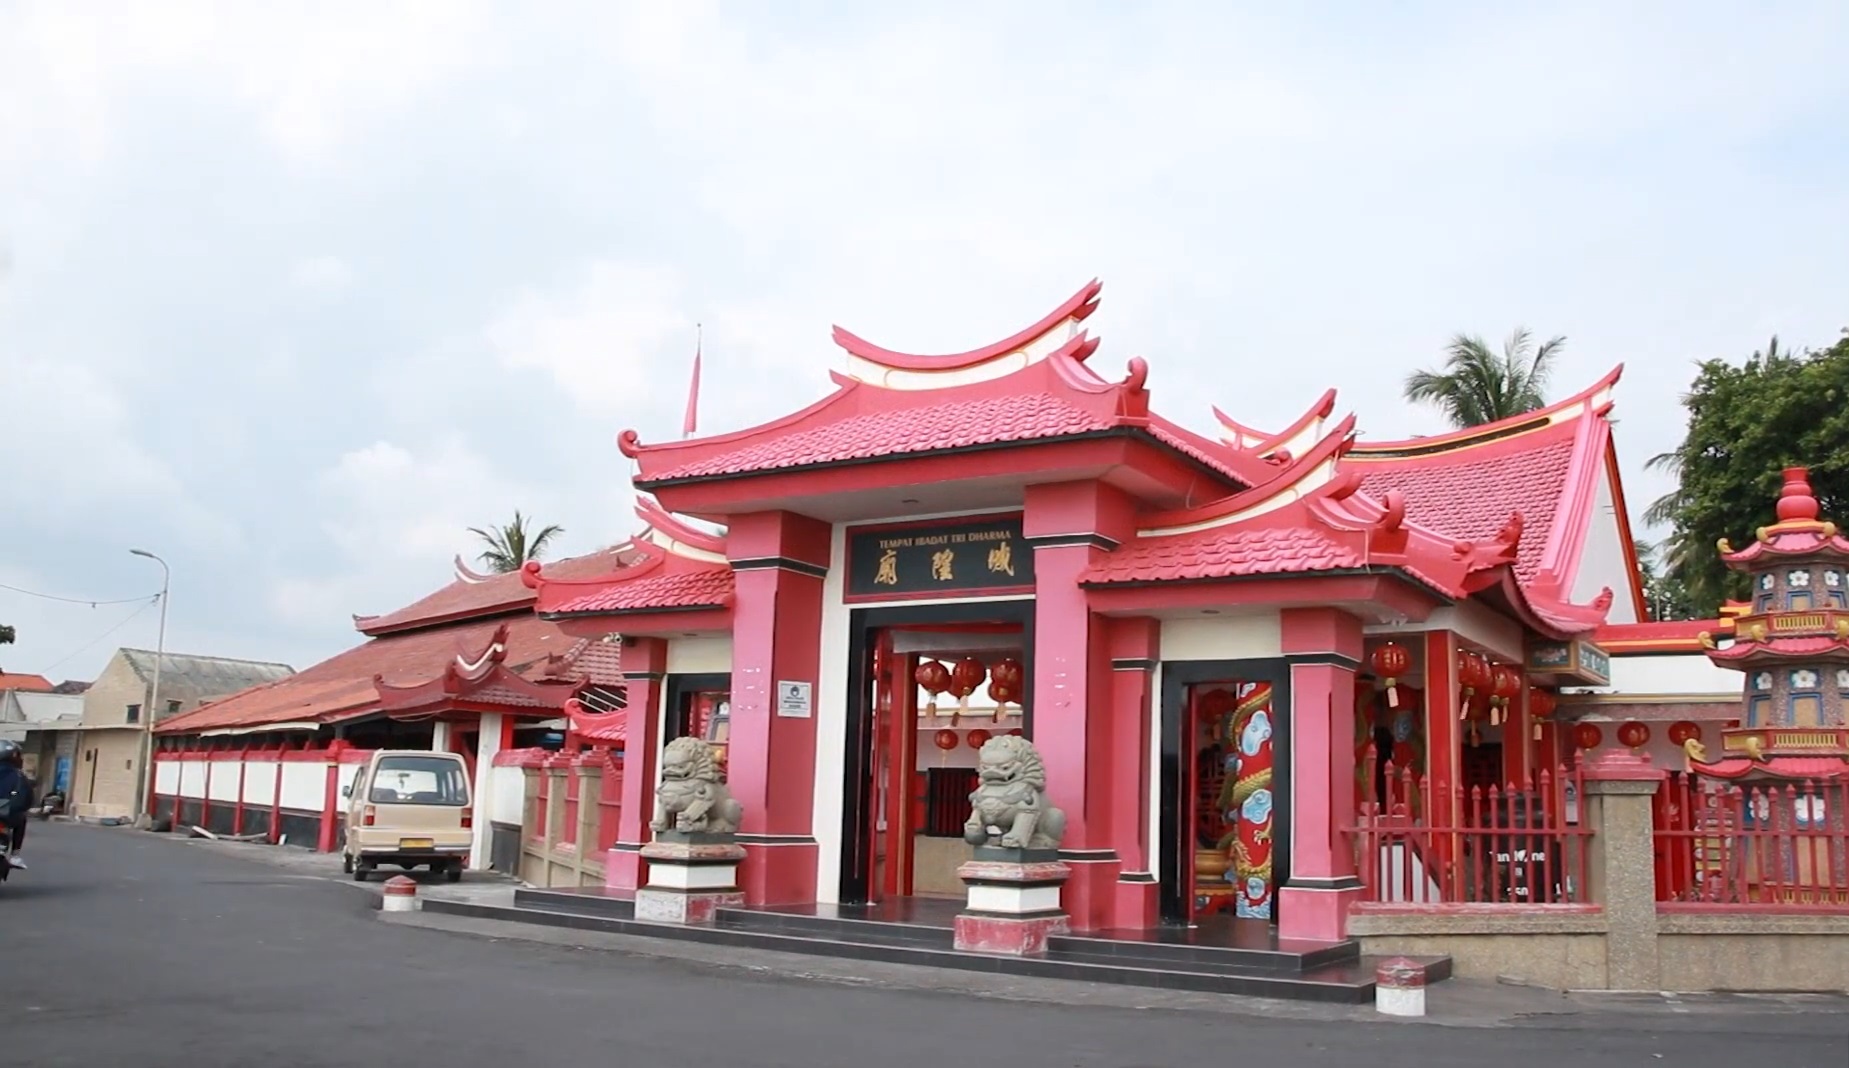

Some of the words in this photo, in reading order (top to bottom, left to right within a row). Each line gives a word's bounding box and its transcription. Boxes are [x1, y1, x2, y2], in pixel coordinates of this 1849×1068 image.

[879, 537, 913, 549] TEMPAT
[915, 534, 948, 546] IBADAT
[951, 533, 966, 543] TRI
[968, 530, 1012, 542] DHARMA
